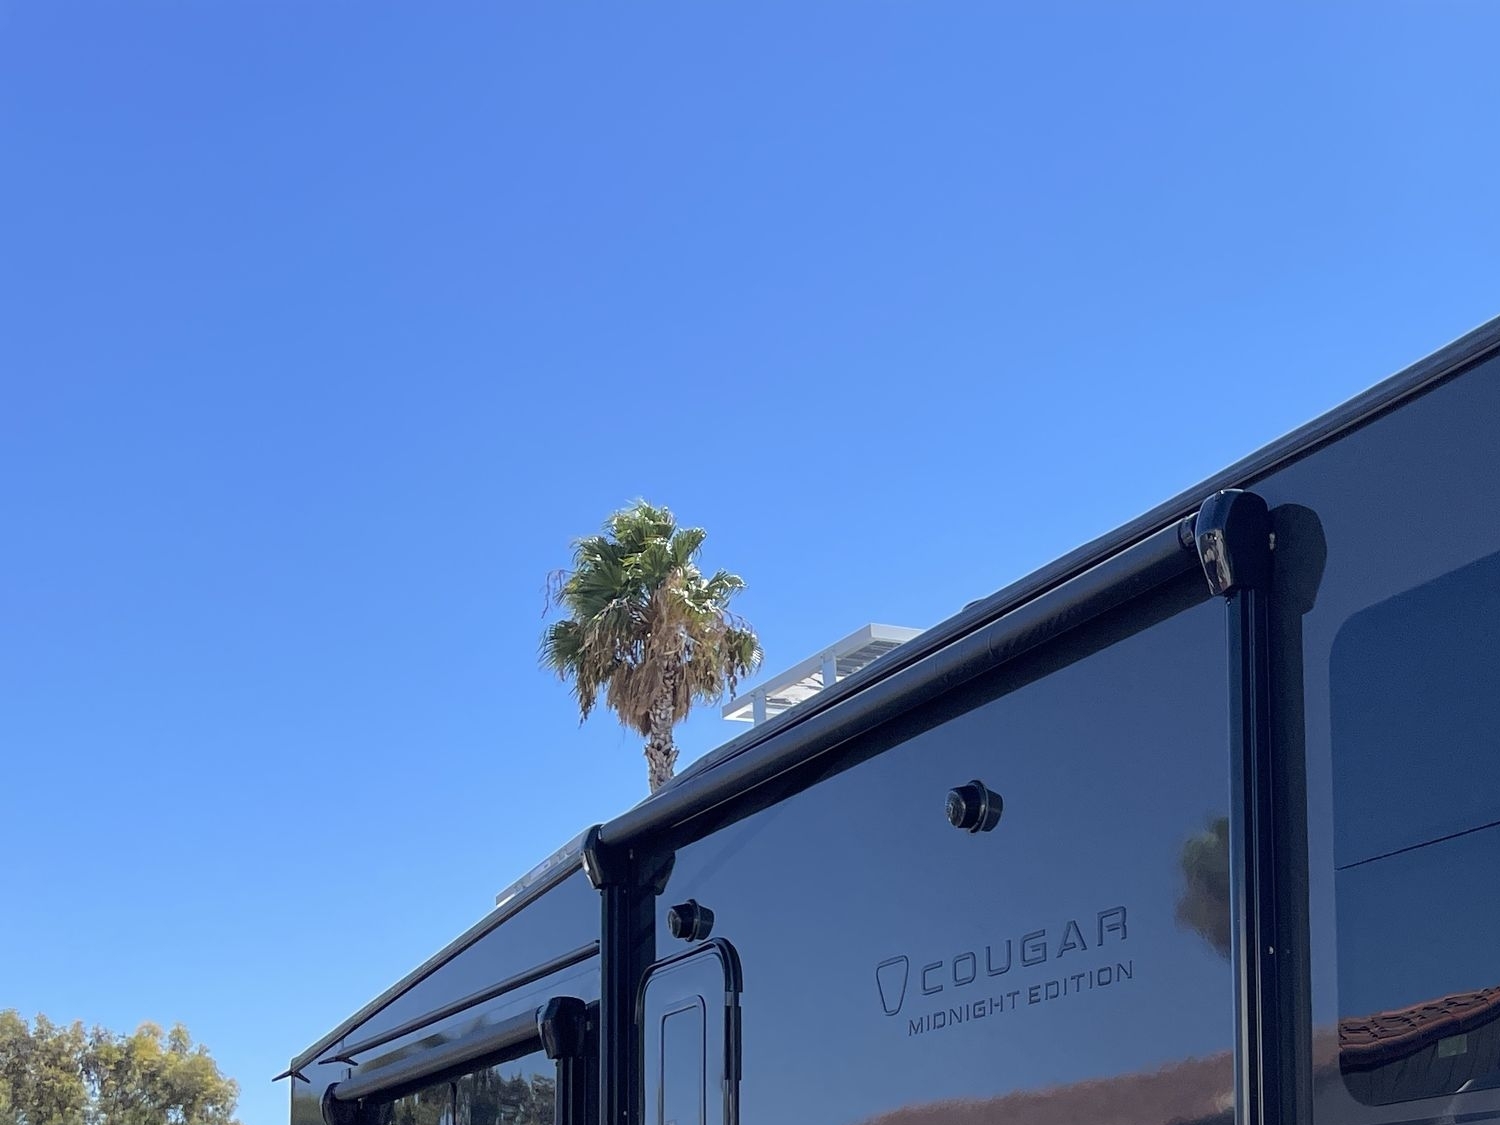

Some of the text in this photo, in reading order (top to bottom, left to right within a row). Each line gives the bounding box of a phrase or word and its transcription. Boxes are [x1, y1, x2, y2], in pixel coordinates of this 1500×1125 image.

[920, 905, 1128, 996] COUGAR
[907, 959, 1134, 1037] MIDNIGHT EDITION
